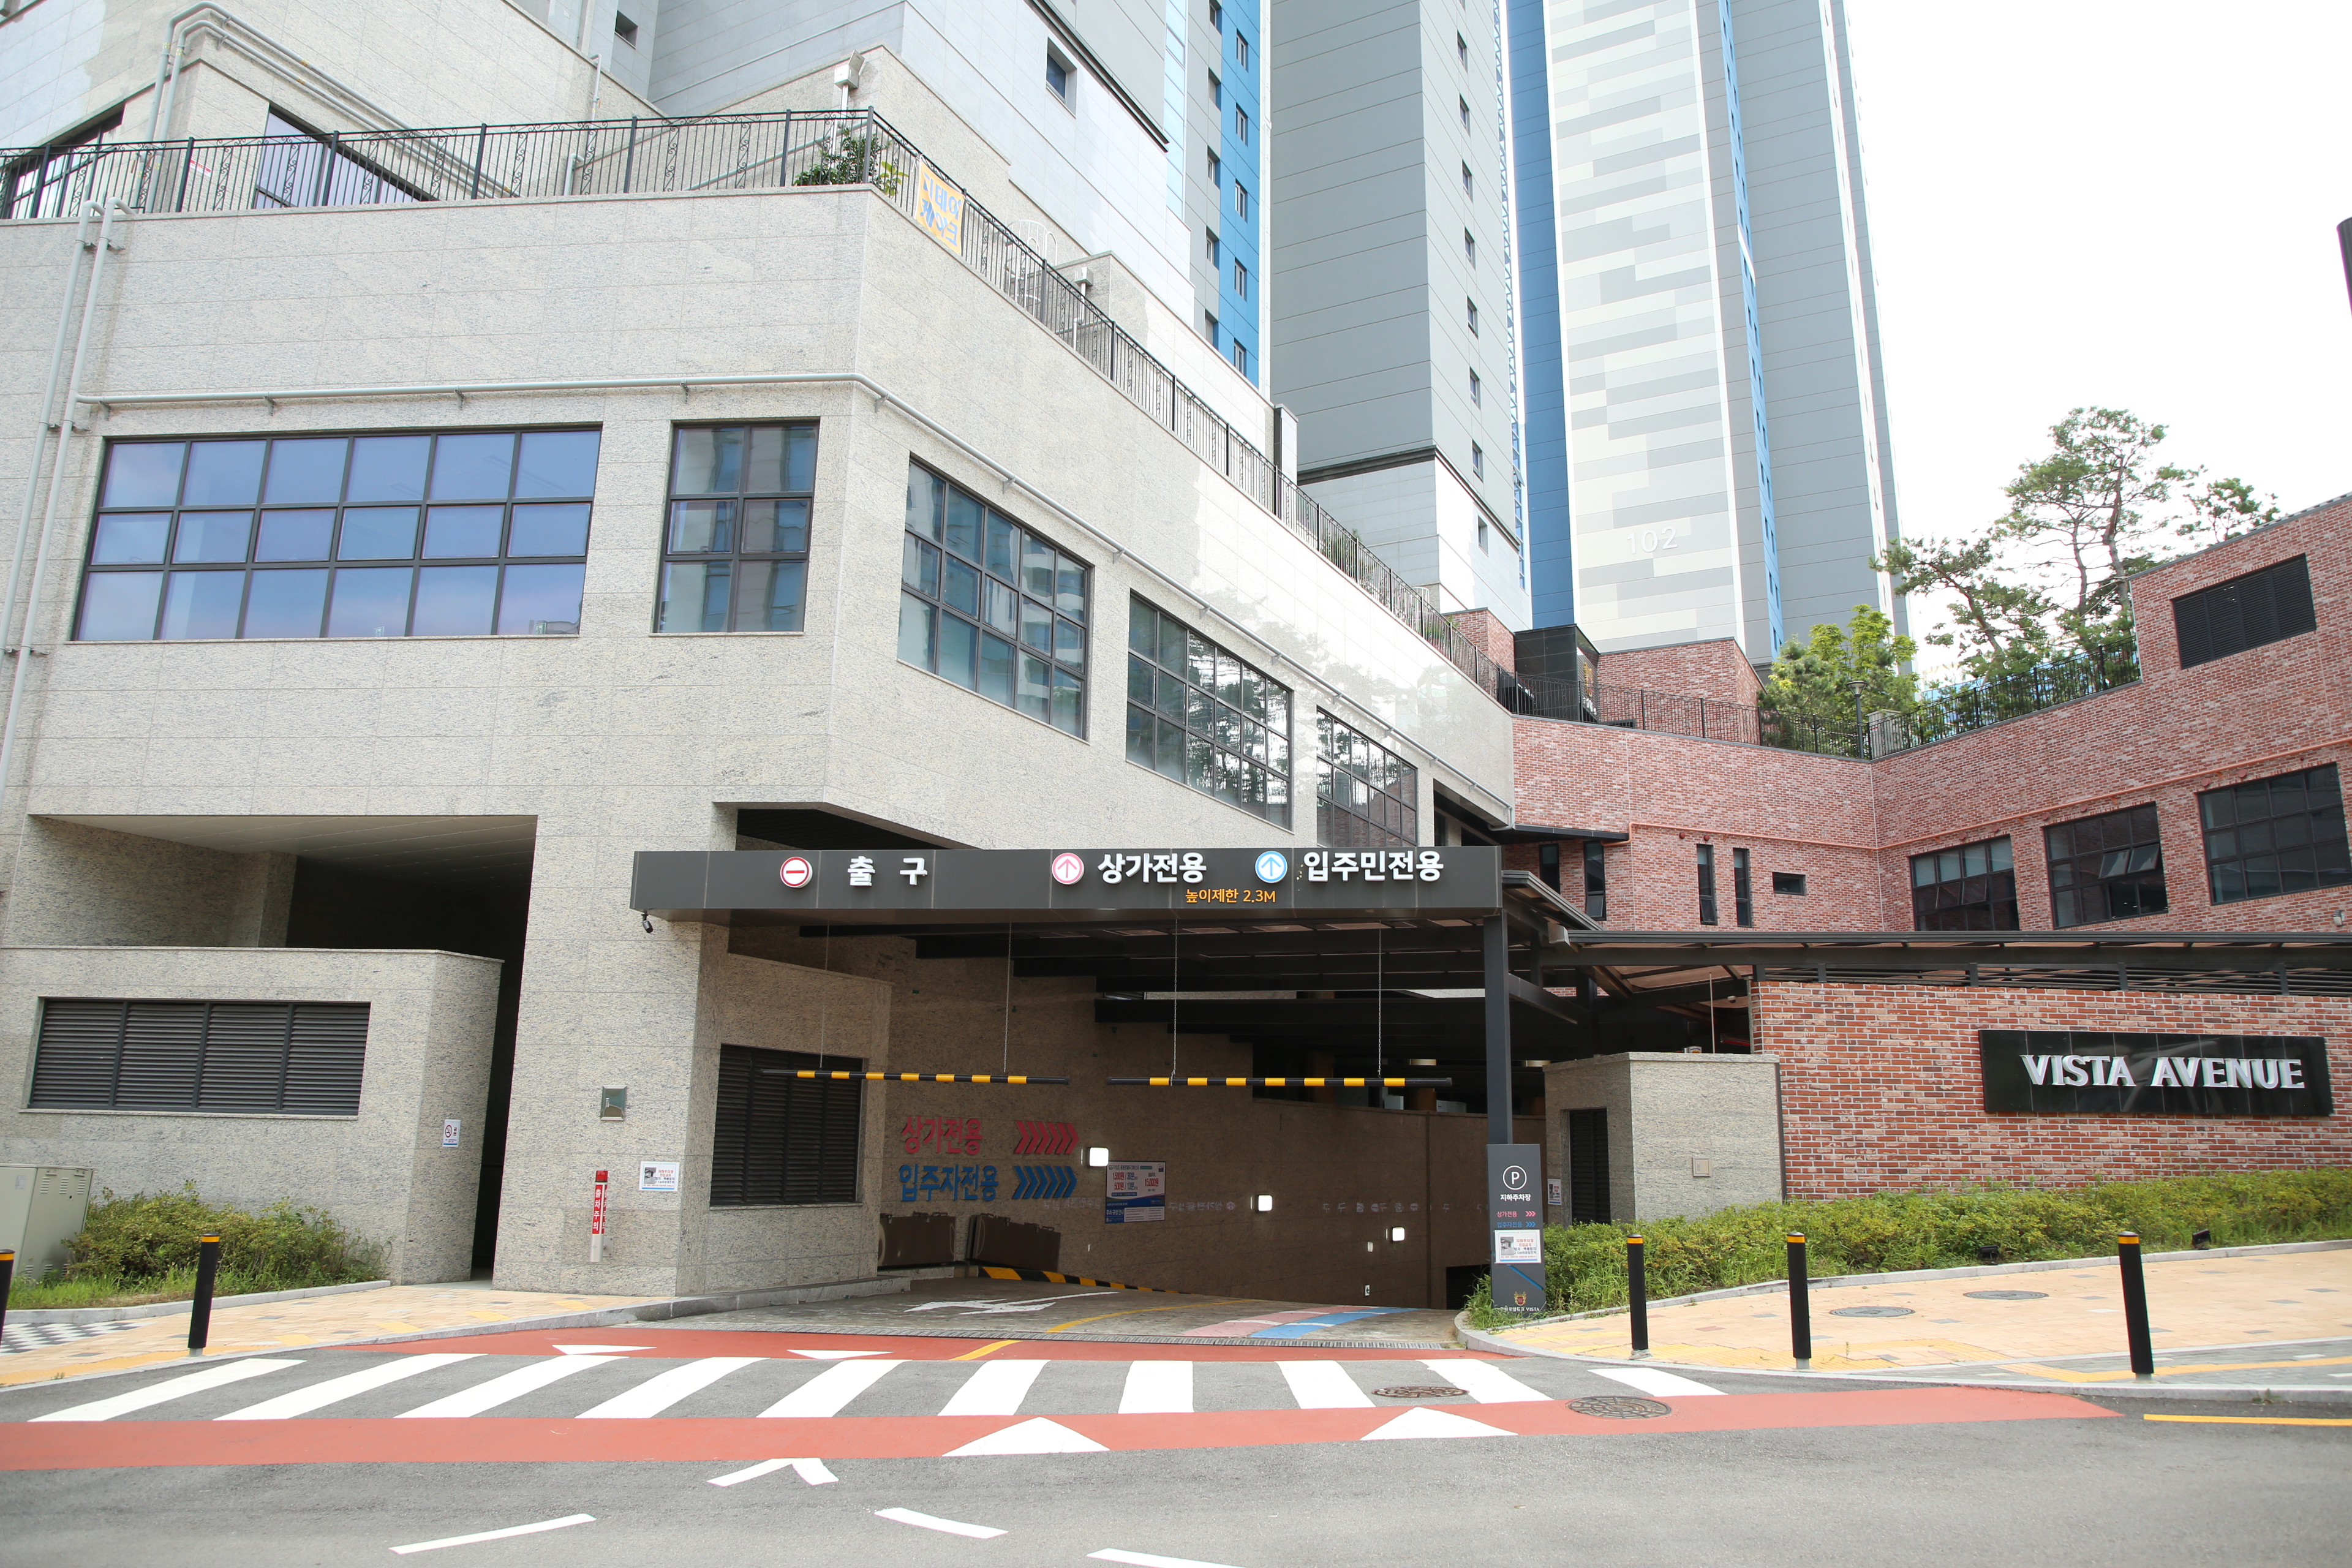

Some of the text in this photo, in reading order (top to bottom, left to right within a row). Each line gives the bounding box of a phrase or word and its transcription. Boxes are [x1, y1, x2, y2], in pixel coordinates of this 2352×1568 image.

[1627, 526, 1678, 554] 102
[848, 856, 928, 886] 출 구
[1097, 852, 1207, 884] 상가전용
[1303, 851, 1444, 882] 입주민전용
[1185, 889, 1276, 903] 높이제한 2.3M
[2019, 1054, 2305, 1088] VISTA AVENUE
[902, 1115, 983, 1155] 상가전용
[899, 1164, 999, 1201] 입주자전용
[1511, 1171, 1520, 1185] P
[593, 1188, 601, 1231] 출차주의
